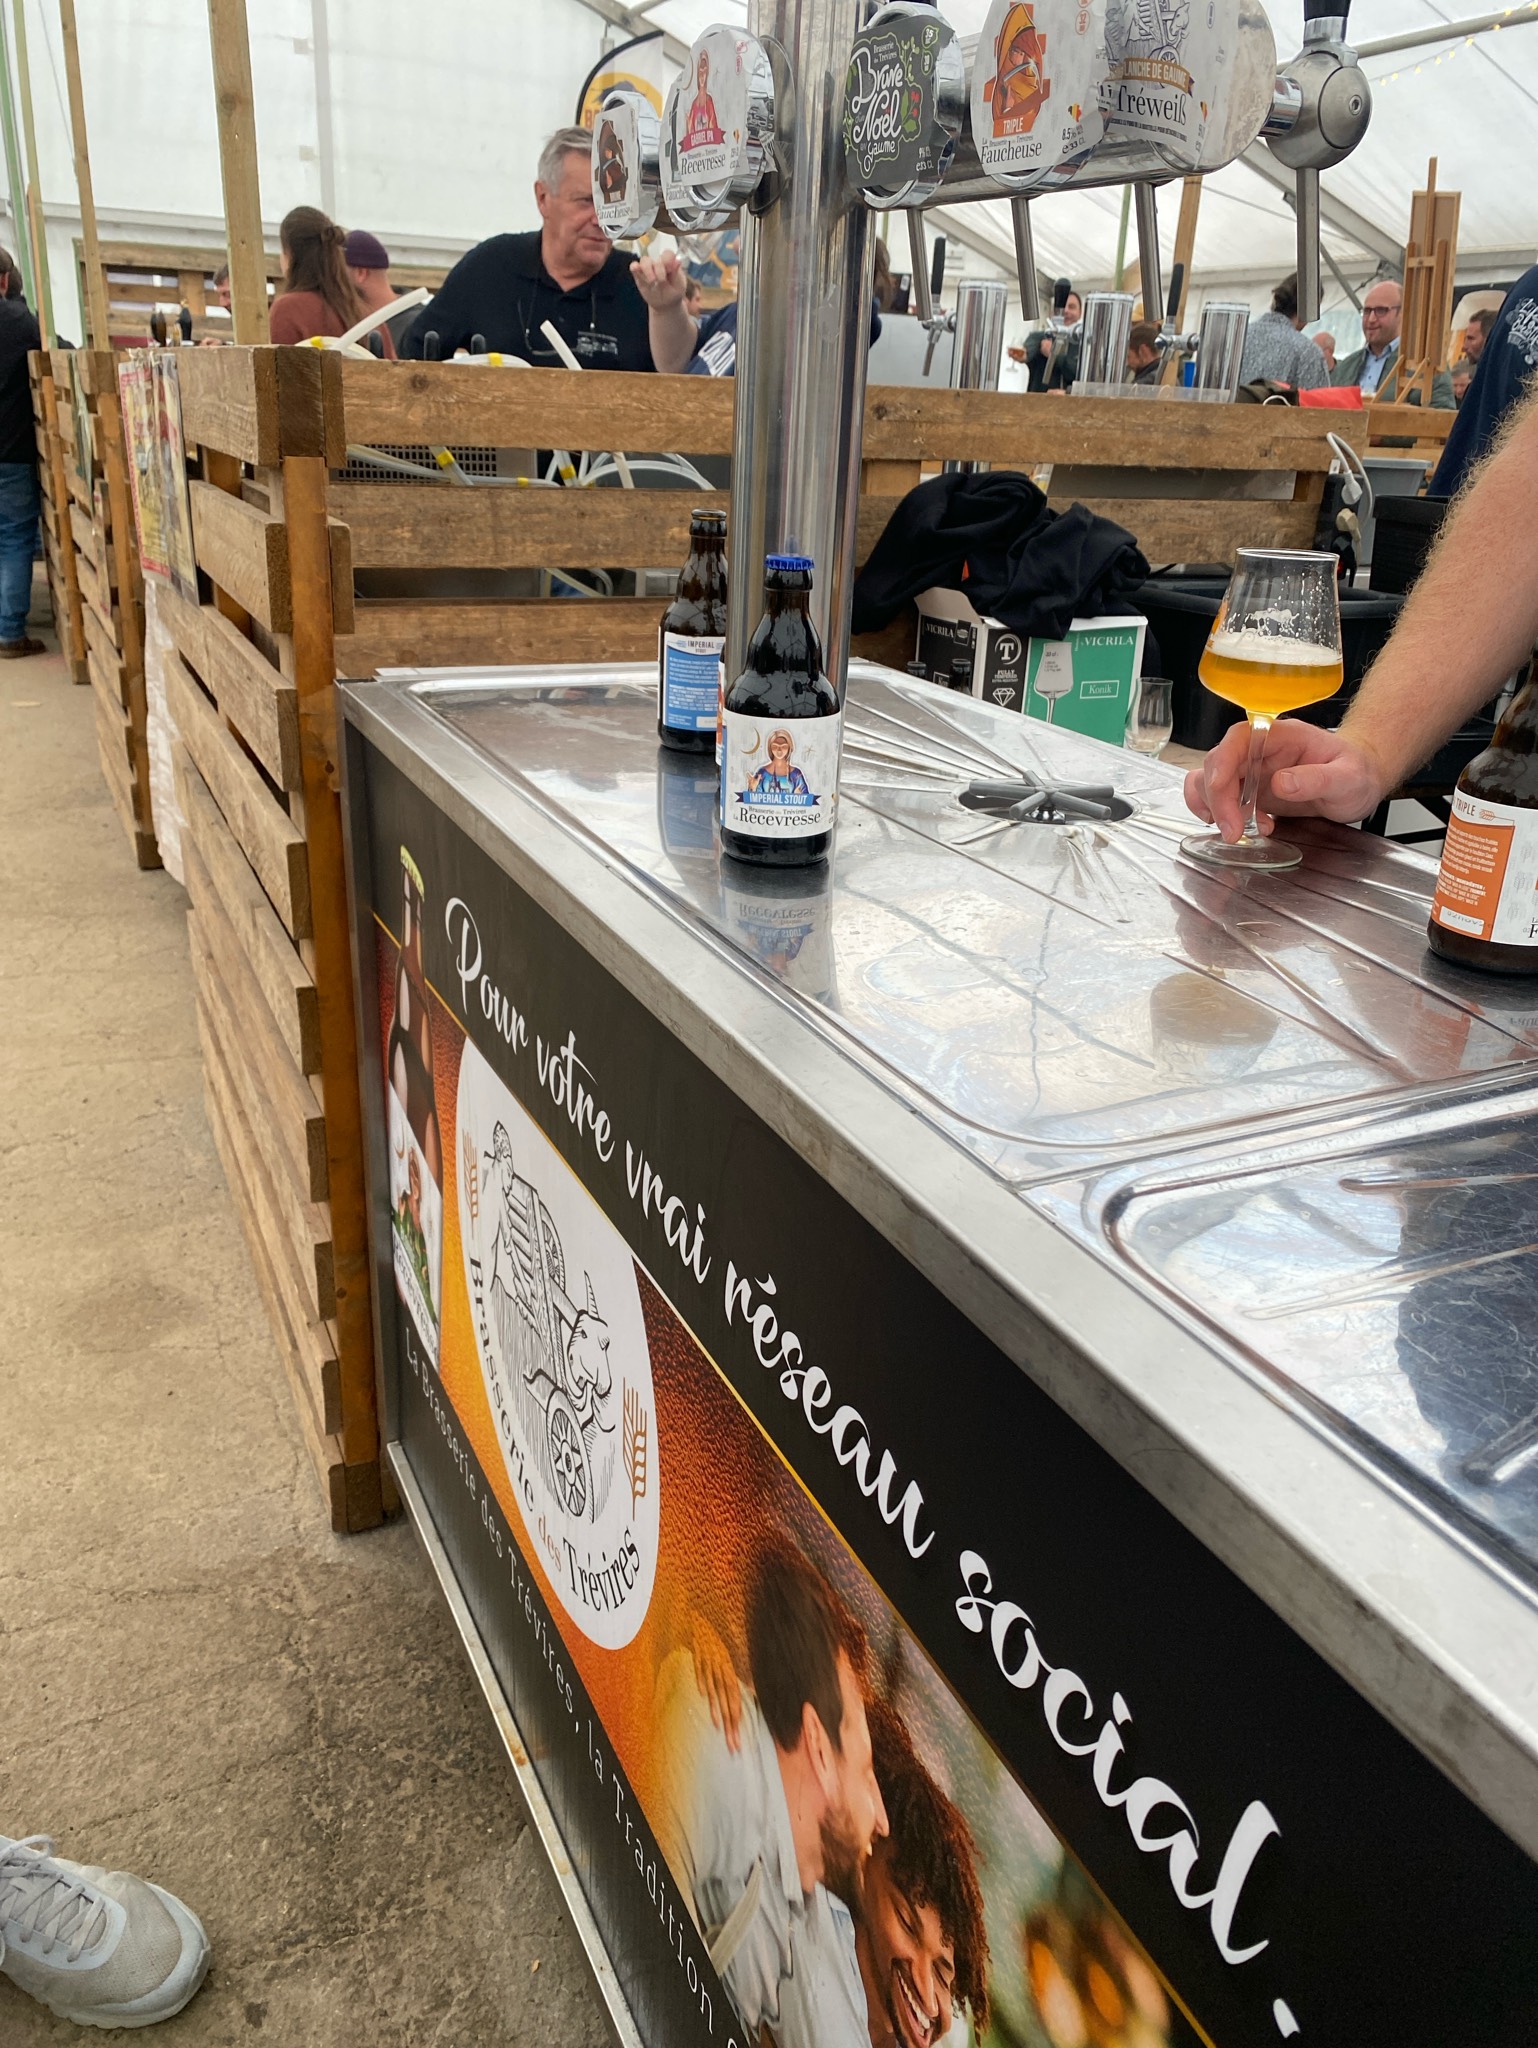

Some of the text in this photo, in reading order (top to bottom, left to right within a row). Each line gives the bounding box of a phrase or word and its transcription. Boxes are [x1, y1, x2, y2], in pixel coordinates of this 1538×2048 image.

[850, 46, 903, 113] Brune
[1152, 62, 1162, 79] DE
[1163, 63, 1187, 88] GAUME
[1003, 117, 1024, 135] TRIPLE
[980, 141, 1042, 164] Faucheuse
[681, 153, 726, 176] Recevresse
[926, 623, 955, 638] VICRILA
[1084, 636, 1134, 646] VICRILA
[687, 641, 715, 649] IMPERIAL
[1088, 684, 1112, 694] Konik
[749, 792, 808, 805] IMPERIAL STOUT
[1455, 798, 1477, 816] TRIPLE
[739, 806, 821, 827] Recevresse
[445, 897, 529, 1056] Pour
[536, 1029, 616, 1163] votre
[625, 1139, 712, 1284] vrai
[724, 1260, 936, 1559] réseau
[469, 1256, 641, 1614] Brasserie des Trévires
[405, 1326, 420, 1377] La
[421, 1360, 477, 1501] Brasserie
[480, 1494, 503, 1559] des
[587, 1719, 605, 1785] la
[611, 1772, 714, 2036] Tradition
